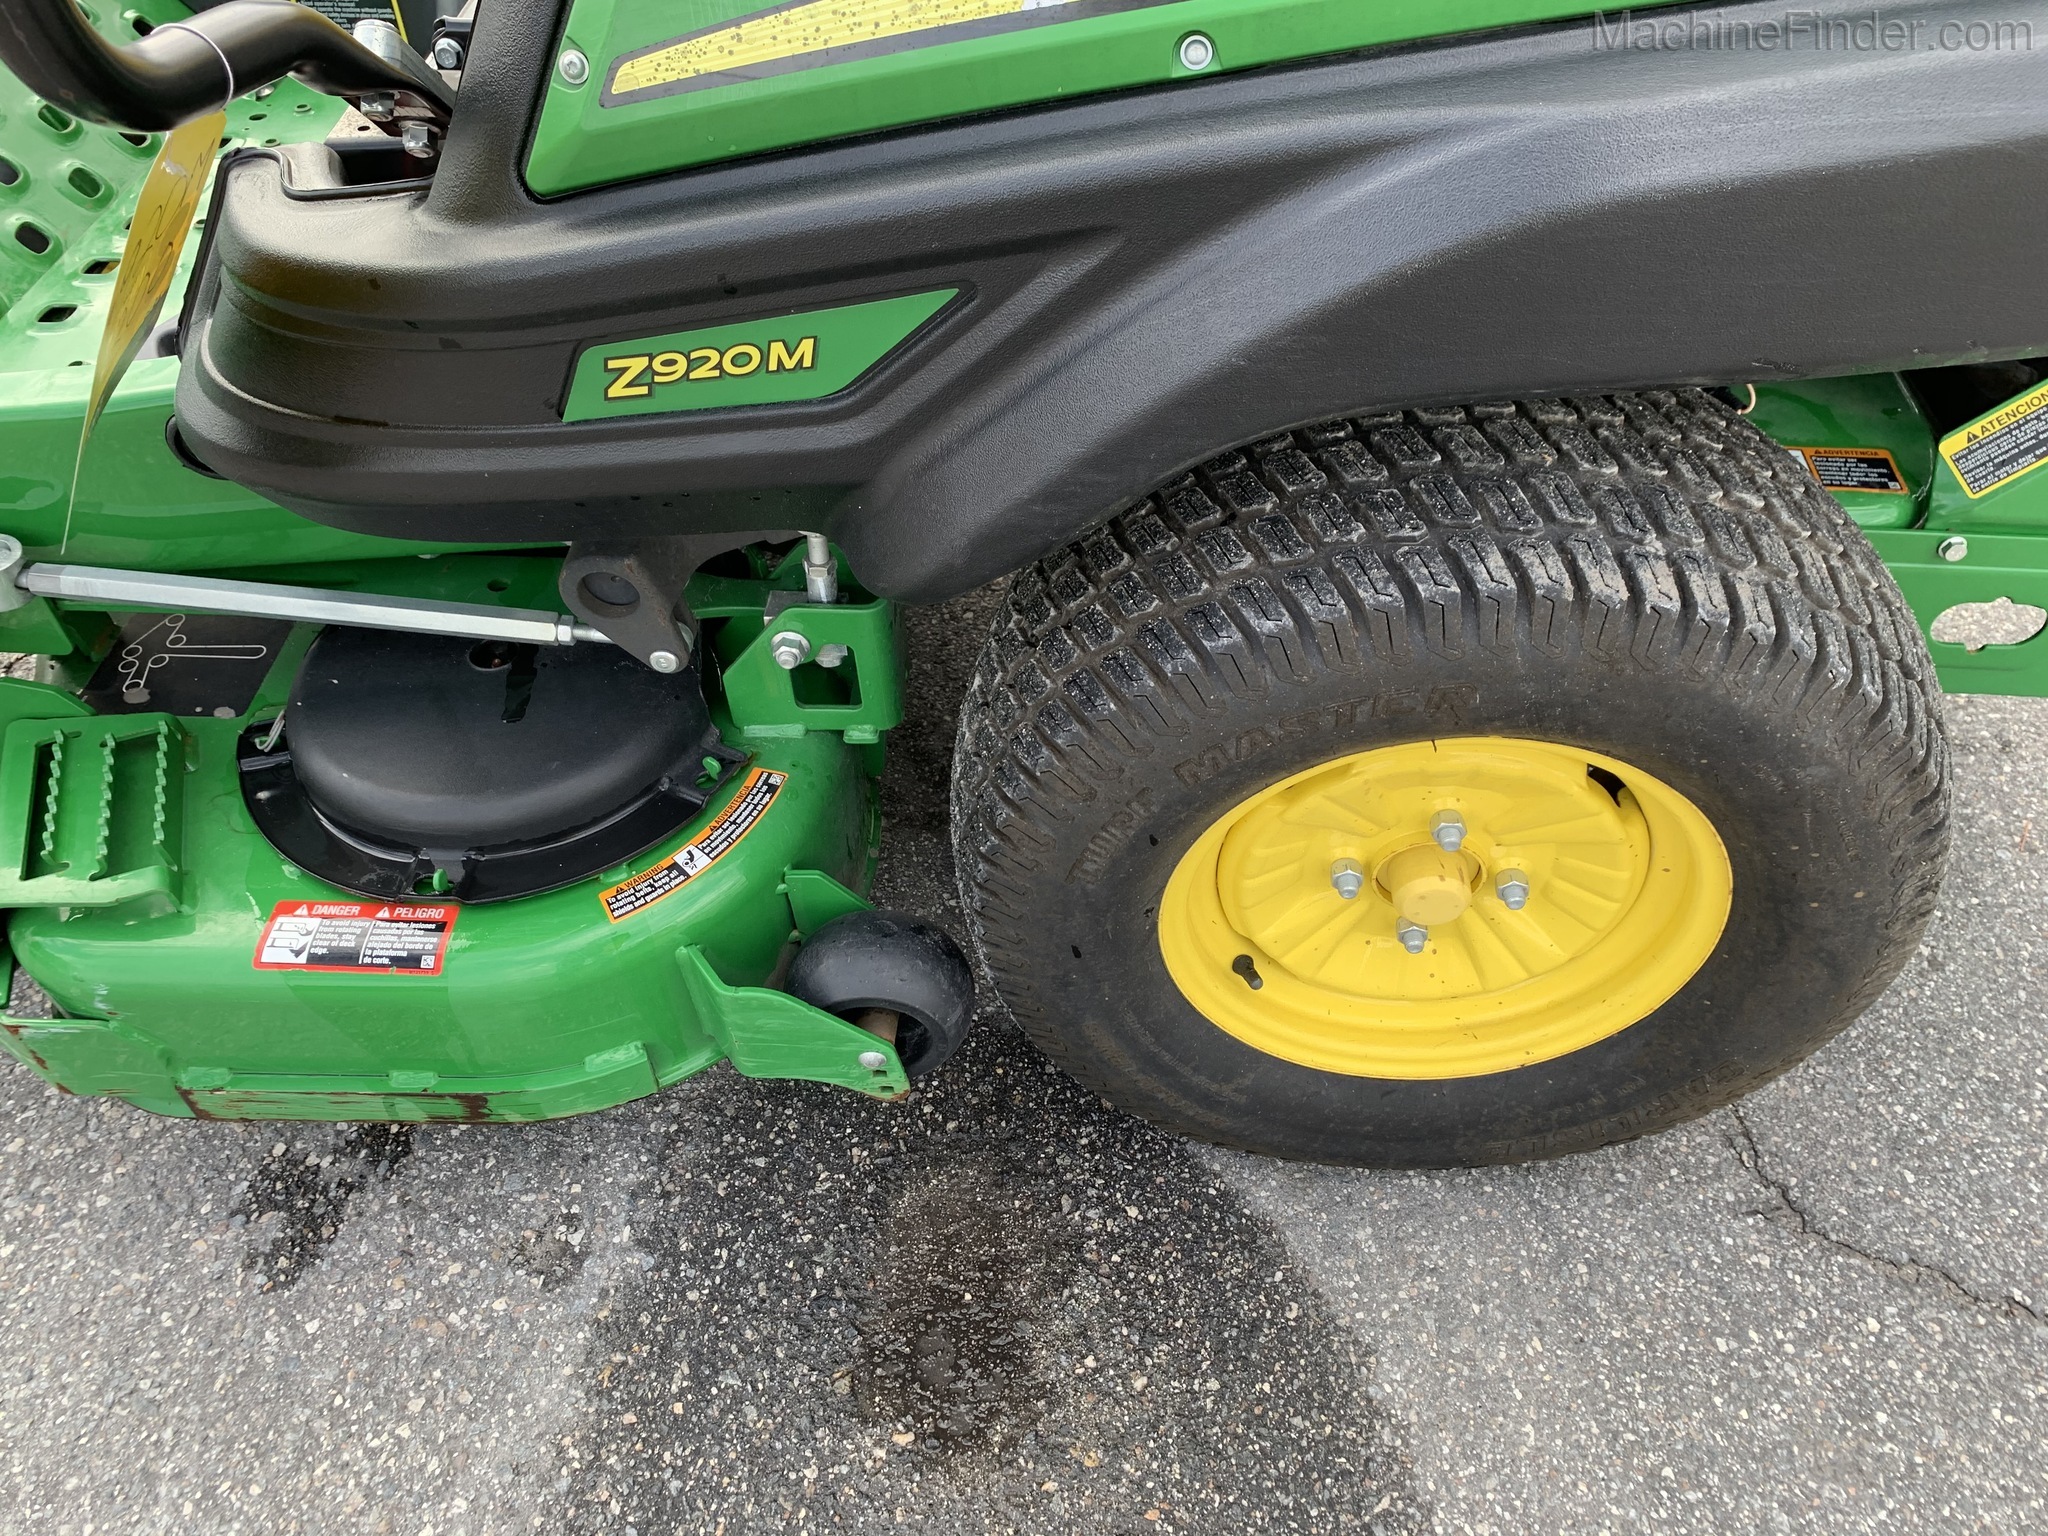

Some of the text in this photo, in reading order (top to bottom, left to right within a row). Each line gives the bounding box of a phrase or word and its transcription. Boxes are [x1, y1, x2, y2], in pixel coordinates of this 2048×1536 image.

[717, 785, 752, 825] ADVERTENCIA
[625, 864, 664, 888] WARNING
[610, 895, 636, 910] rotating
[654, 877, 670, 888] keep
[670, 869, 679, 879] all
[617, 888, 635, 899] avoid
[635, 879, 654, 892] injury
[653, 869, 669, 881] from
[613, 904, 634, 917] shields
[634, 897, 646, 908] and
[645, 888, 665, 902] guards
[311, 904, 361, 916] DANGER
[393, 907, 445, 919] PELIGRO
[351, 920, 372, 928] injury
[335, 926, 362, 935] rotating
[341, 933, 356, 942] stay
[310, 946, 330, 956] edge.
[365, 948, 408, 957] la plataforma
[363, 956, 392, 965] de corte.
